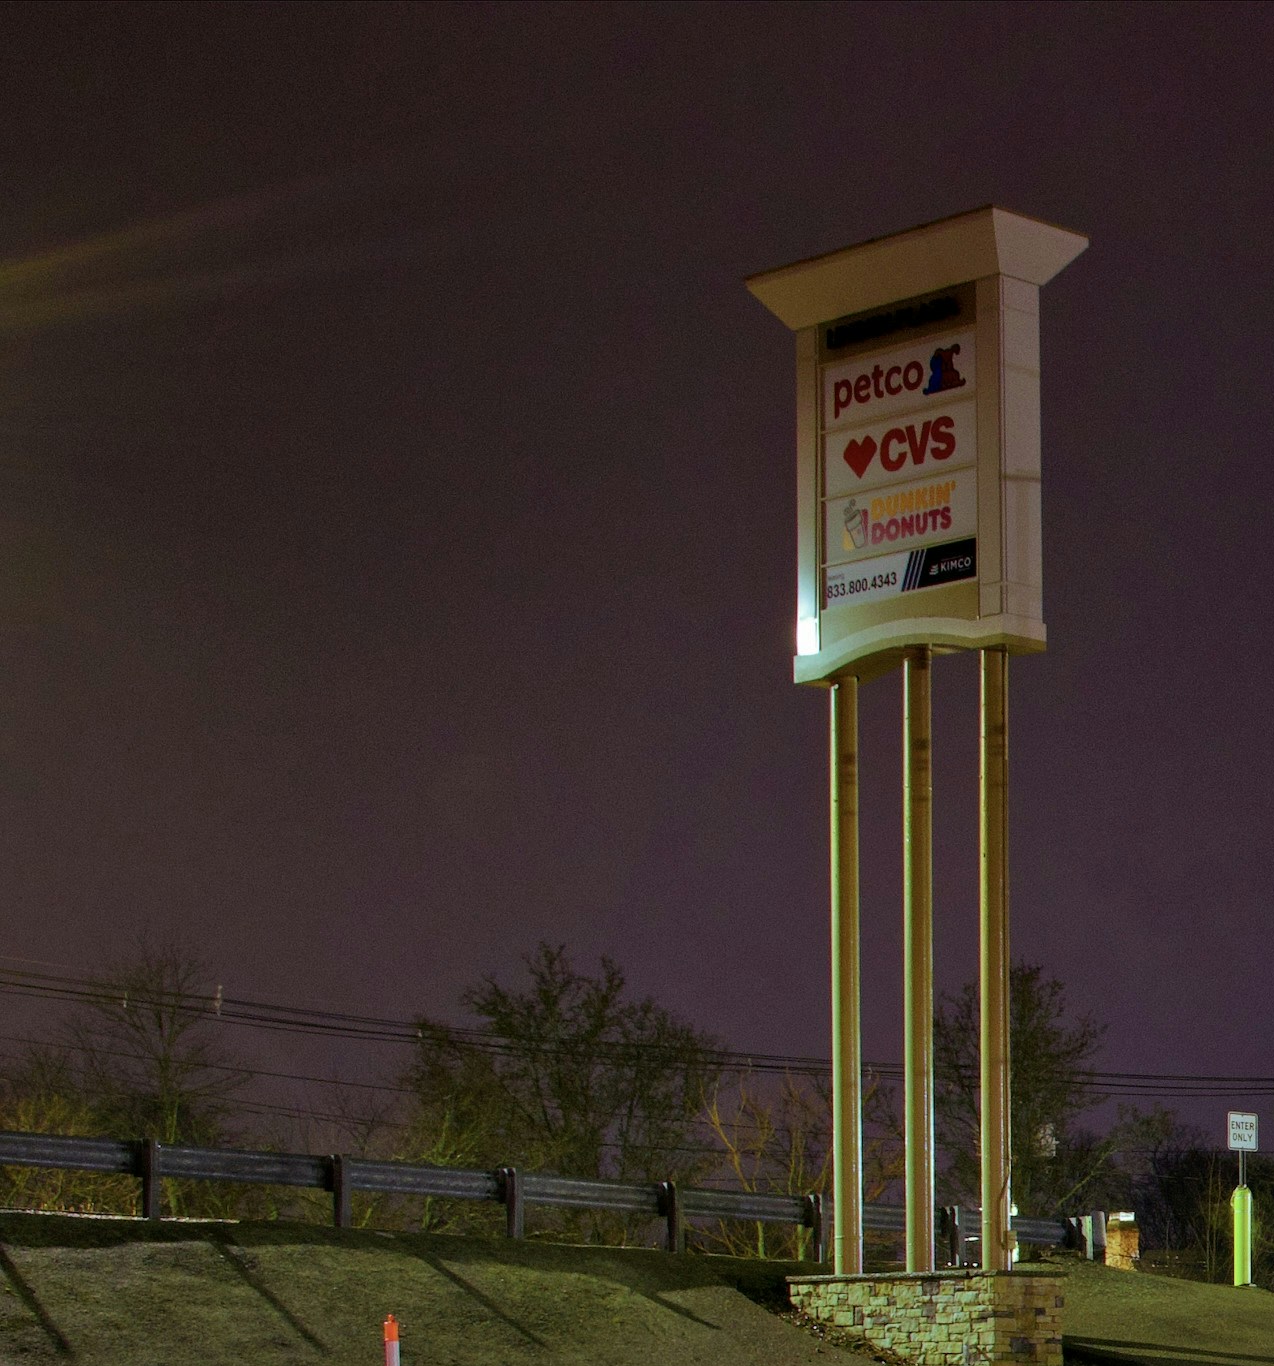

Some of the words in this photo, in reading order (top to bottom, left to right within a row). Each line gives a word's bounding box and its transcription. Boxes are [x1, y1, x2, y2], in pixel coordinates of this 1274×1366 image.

[833, 359, 924, 419] petco
[880, 415, 957, 472] CVS
[871, 480, 957, 521] DUNKIN'
[871, 506, 952, 545] DONUTS
[940, 556, 972, 573] KIMCO
[827, 571, 897, 599] 833.800.4343
[1231, 1121, 1255, 1130] ENTER
[1232, 1133, 1253, 1142] ONLY
